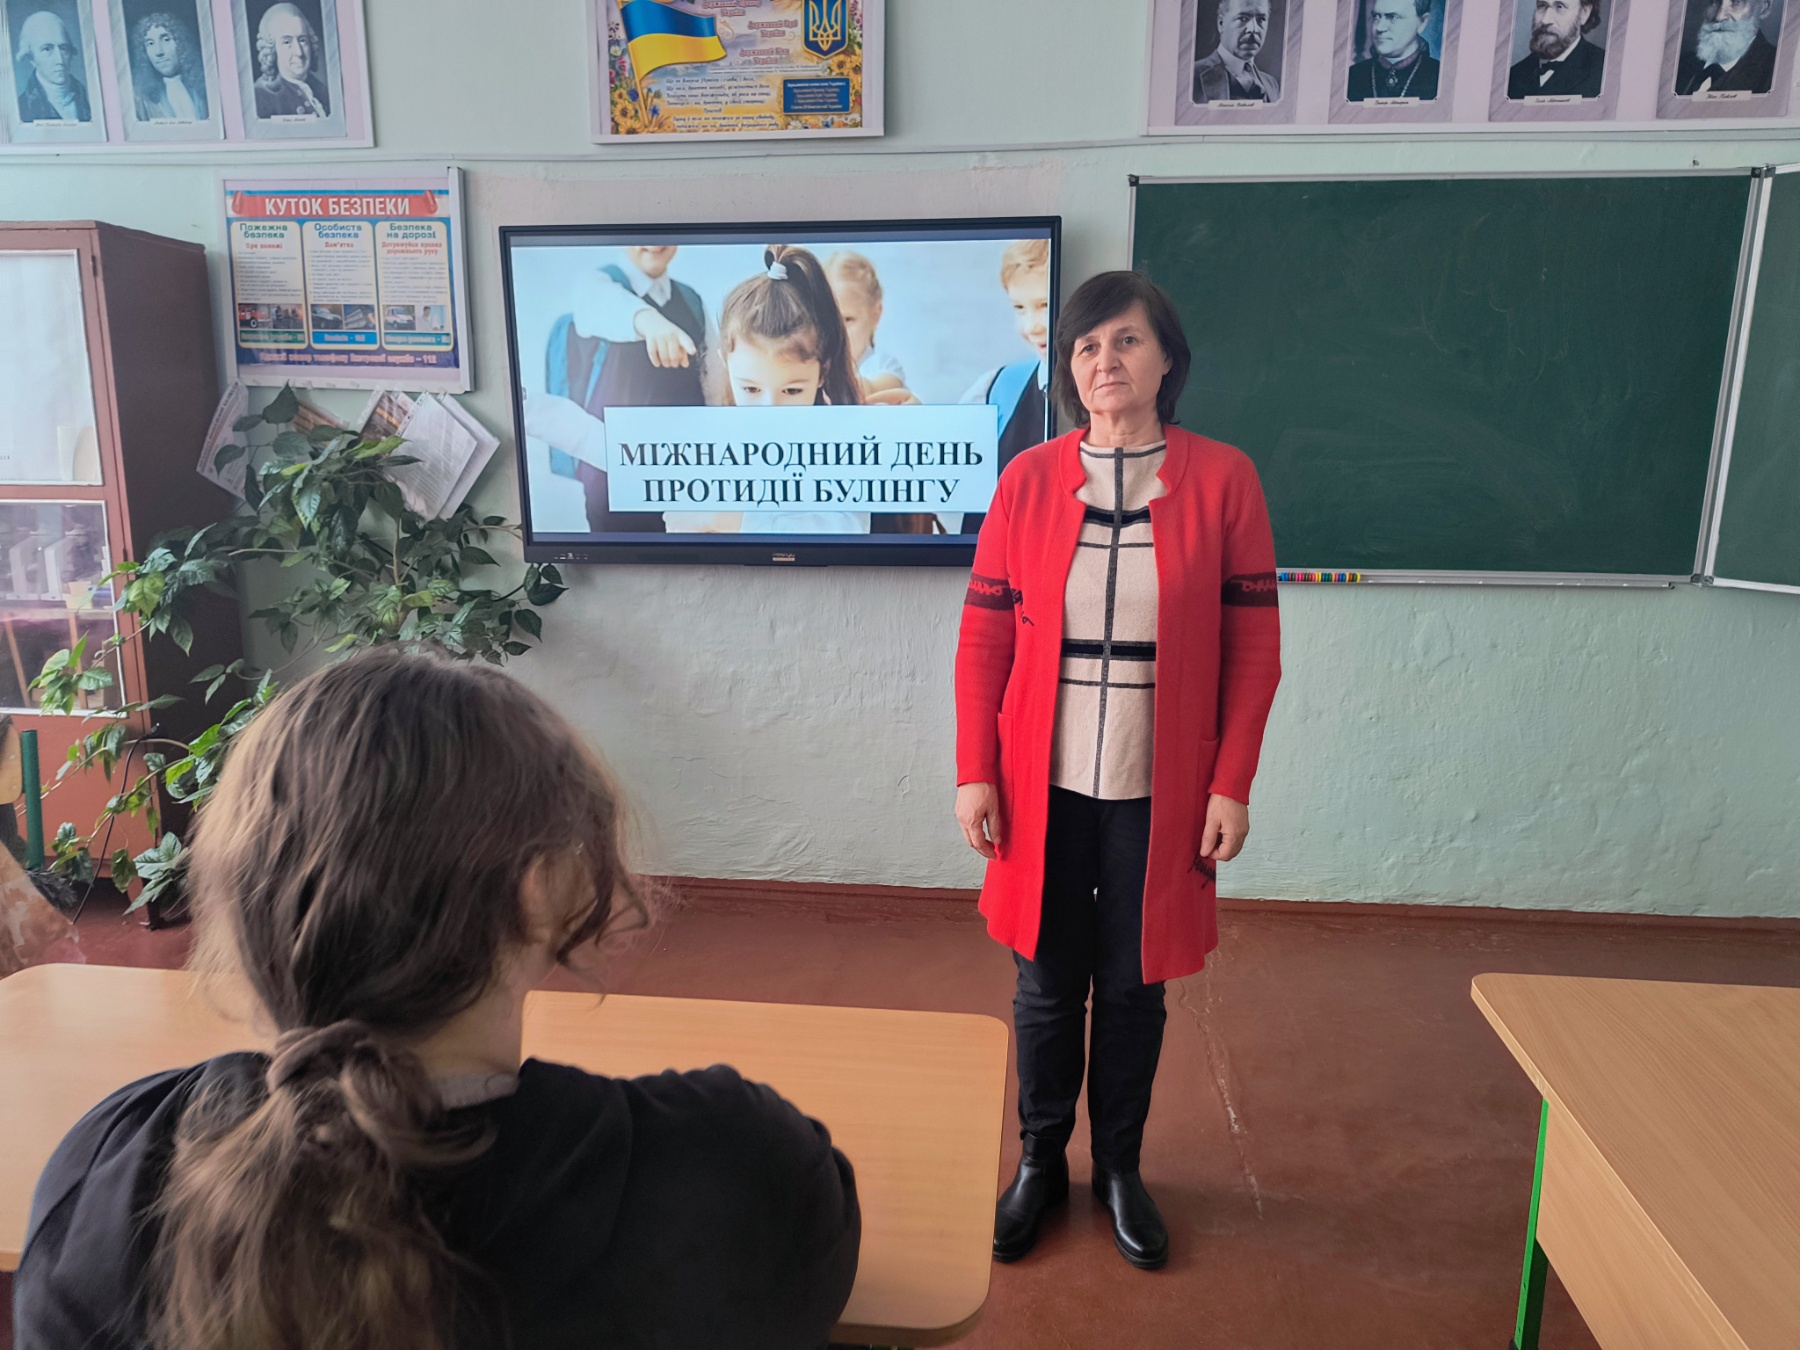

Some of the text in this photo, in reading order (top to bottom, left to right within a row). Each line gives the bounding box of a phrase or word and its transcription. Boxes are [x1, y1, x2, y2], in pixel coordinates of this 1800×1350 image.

[264, 197, 410, 216] КУТОК БЕЗПЕКИ
[239, 222, 288, 232] Пожежна
[314, 222, 362, 232] Особиста
[389, 222, 433, 232] Безпека
[243, 230, 285, 239] безпека
[318, 230, 359, 239] безпека
[401, 231, 436, 241] дорозі
[618, 434, 984, 472] МІЖНАРОДНИЙ ДЕНЬ
[642, 472, 960, 508] ПРОТИДІЇ БУЛІНГУ
